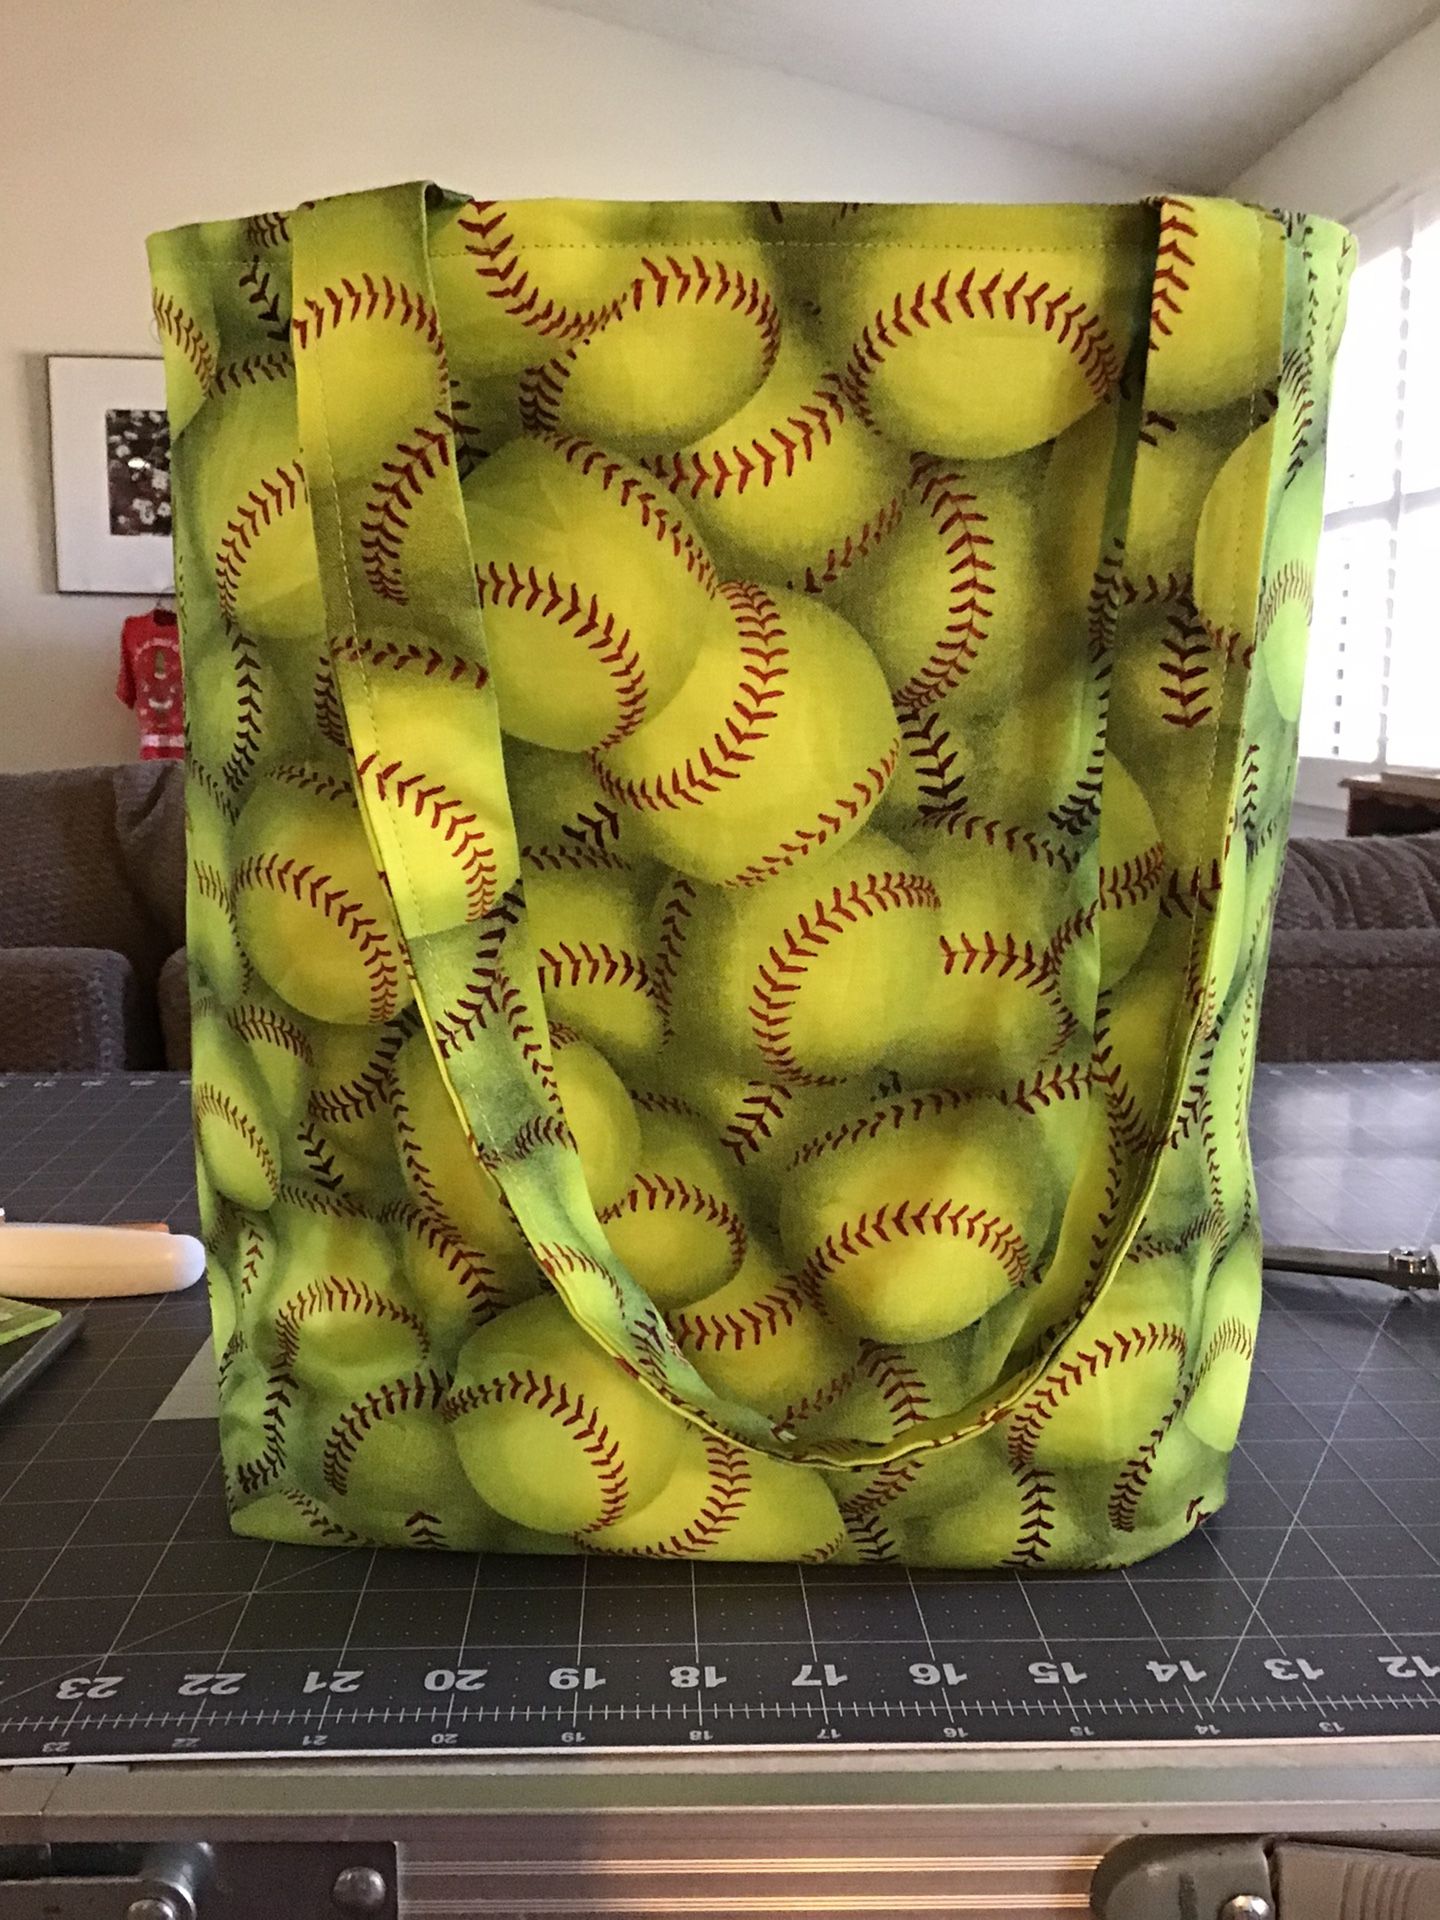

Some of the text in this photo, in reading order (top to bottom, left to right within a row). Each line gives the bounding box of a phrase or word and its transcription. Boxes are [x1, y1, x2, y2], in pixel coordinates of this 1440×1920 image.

[670, 1666, 728, 1688] 18
[792, 1664, 848, 1687] 17
[908, 1663, 968, 1686] 16
[1028, 1662, 1088, 1684] 15
[1146, 1660, 1206, 1682] 14
[1263, 1658, 1325, 1680] 13
[1377, 1656, 1440, 1678] 12
[56, 1677, 124, 1700] 23
[178, 1673, 247, 1696] 22
[302, 1670, 365, 1694] 21
[424, 1669, 488, 1692] 20
[548, 1668, 606, 1690] 19
[431, 1733, 458, 1744] 20
[561, 1732, 586, 1743] 19
[689, 1730, 714, 1740] 18
[816, 1728, 842, 1739] 17
[943, 1727, 969, 1738] 16
[1070, 1726, 1095, 1737] 15
[1194, 1724, 1221, 1735] 14
[1318, 1722, 1346, 1733] 13
[42, 1741, 71, 1752] 23
[302, 1734, 328, 1746] 21
